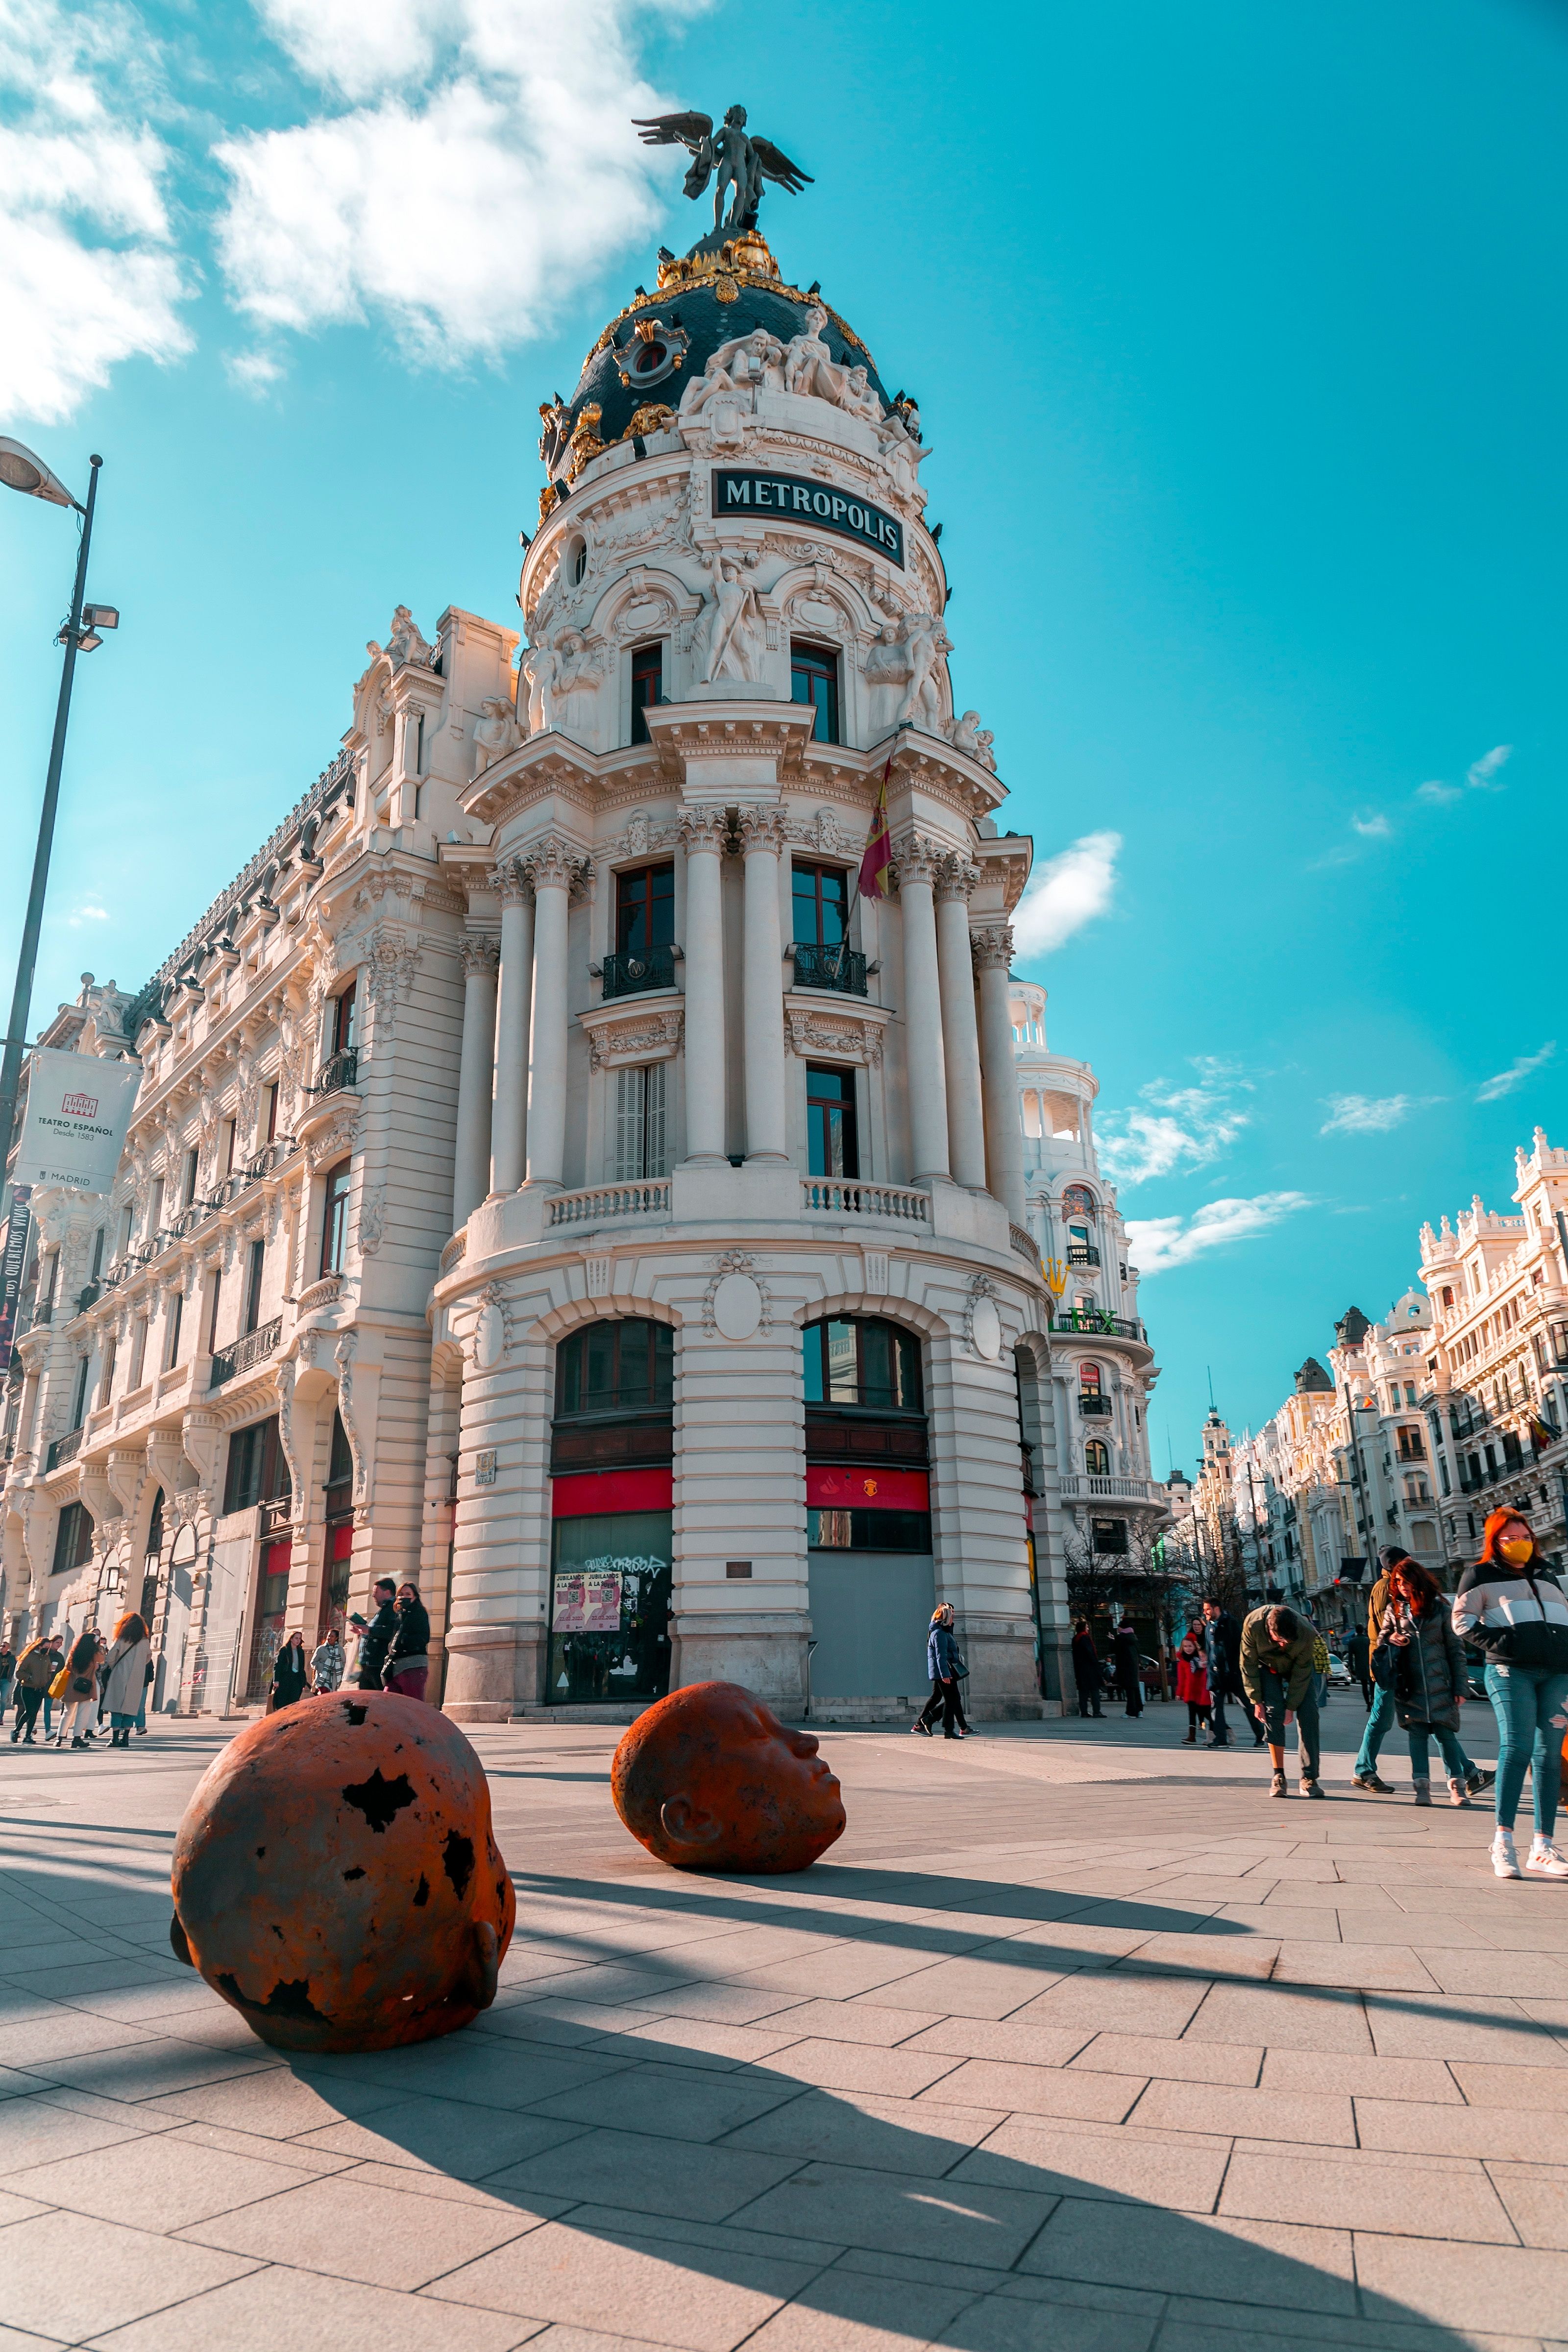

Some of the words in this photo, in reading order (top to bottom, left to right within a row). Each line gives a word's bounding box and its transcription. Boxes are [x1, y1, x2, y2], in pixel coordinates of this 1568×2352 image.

[726, 480, 898, 551] METROPOLIS
[38, 1117, 70, 1127] TEATRO
[74, 1123, 113, 1136] ESPAÑOL
[53, 1128, 74, 1138] Desde
[77, 1132, 94, 1141] 1583
[51, 1173, 90, 1186] MADRID
[12, 1203, 28, 1226] VIVAS
[5, 1229, 25, 1276] QUEREMOS
[601, 1580, 619, 1589] SUERTE
